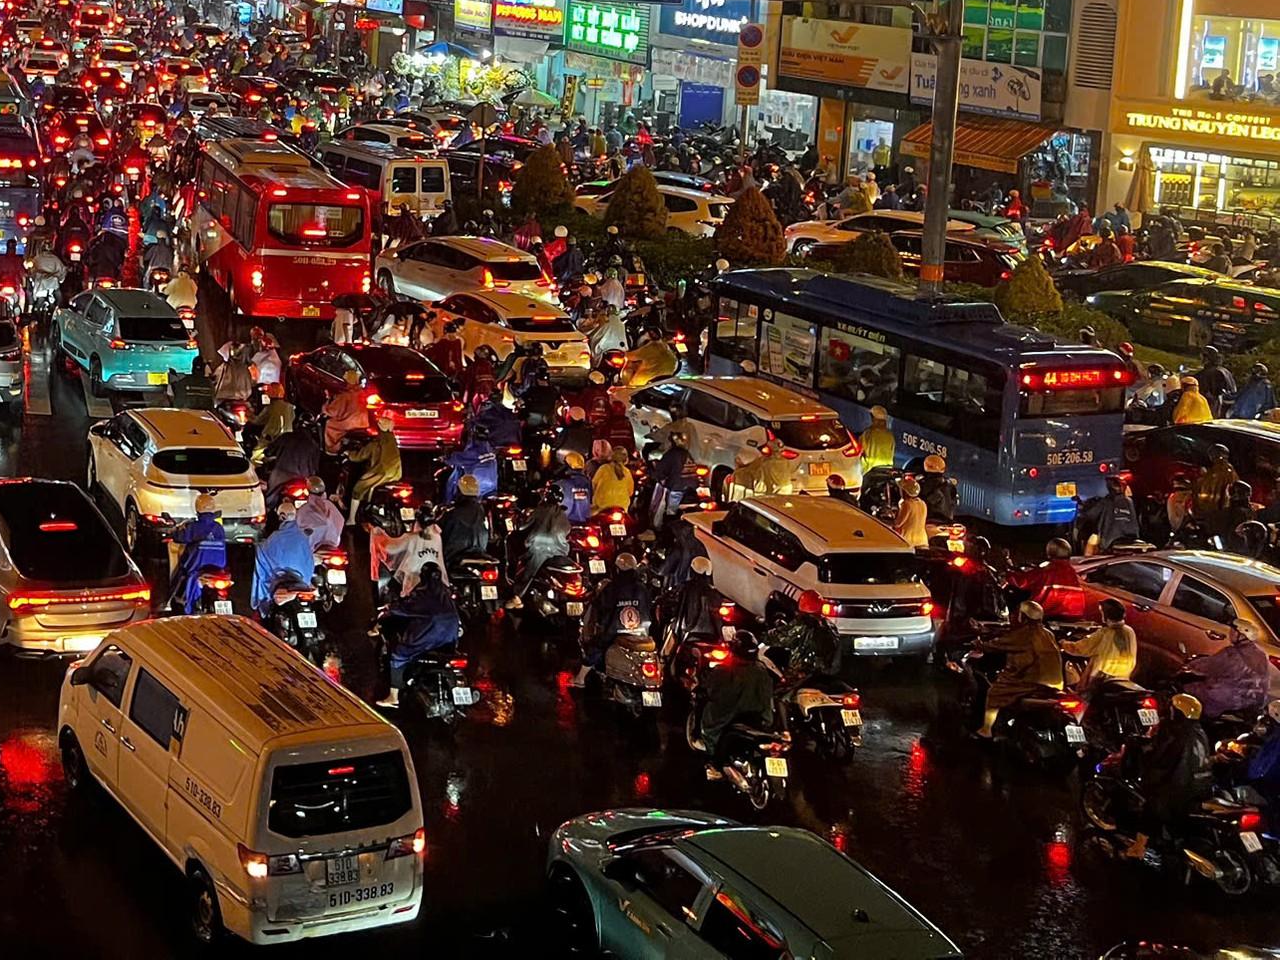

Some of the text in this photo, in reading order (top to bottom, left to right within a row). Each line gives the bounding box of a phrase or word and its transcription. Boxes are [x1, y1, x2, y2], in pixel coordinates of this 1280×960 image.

[972, 83, 996, 99] xanh
[1126, 112, 1182, 131] TRUNG
[1181, 119, 1249, 138] NGUYÊN
[902, 431, 918, 448] 50E
